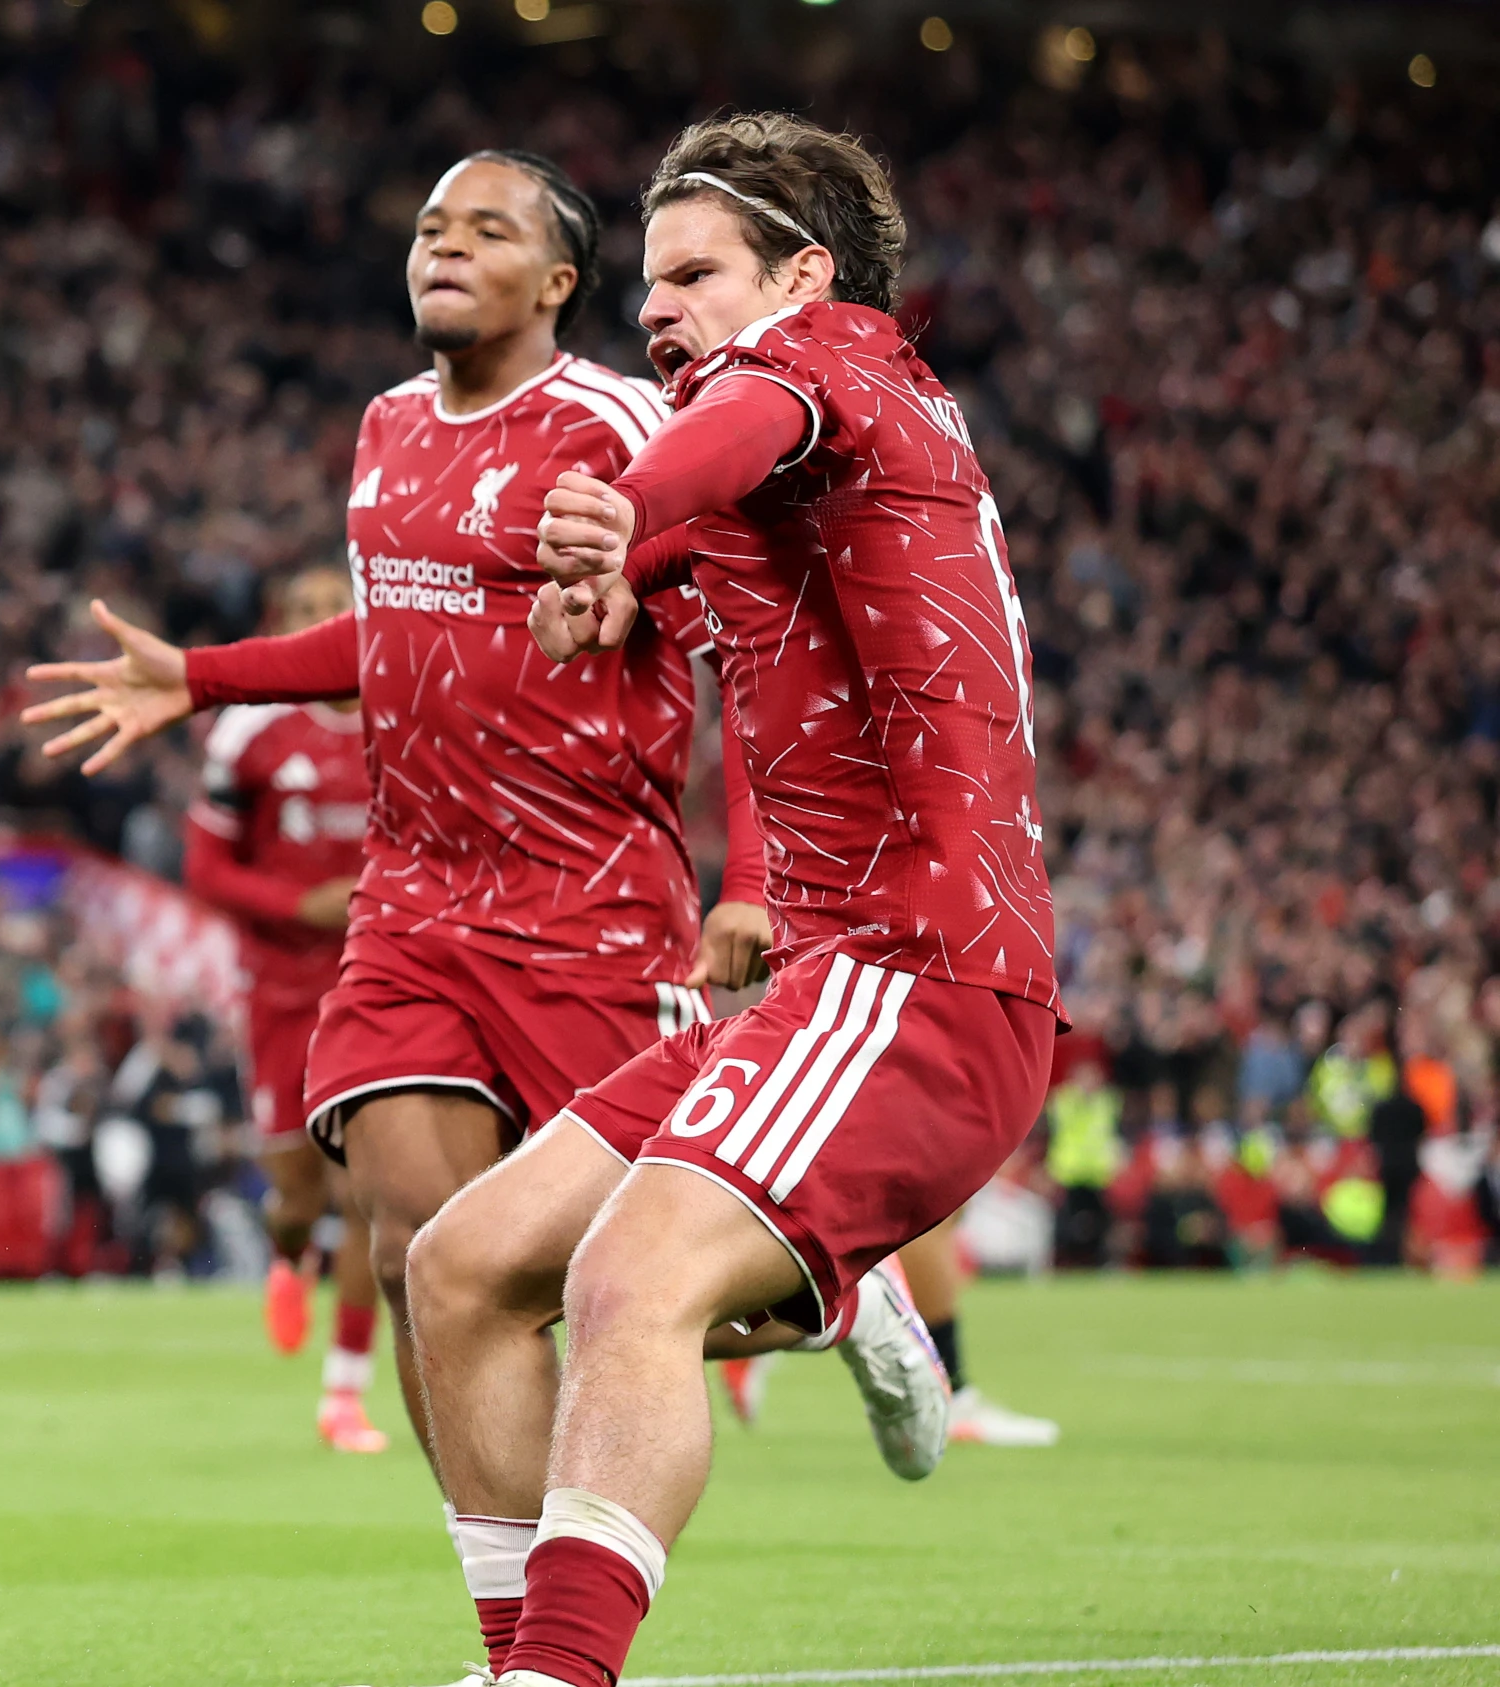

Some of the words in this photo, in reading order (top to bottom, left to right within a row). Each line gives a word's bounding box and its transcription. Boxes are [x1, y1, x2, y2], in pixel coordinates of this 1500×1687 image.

[369, 552, 474, 588] standard
[370, 581, 485, 615] chartered
[670, 1057, 762, 1138] 6
